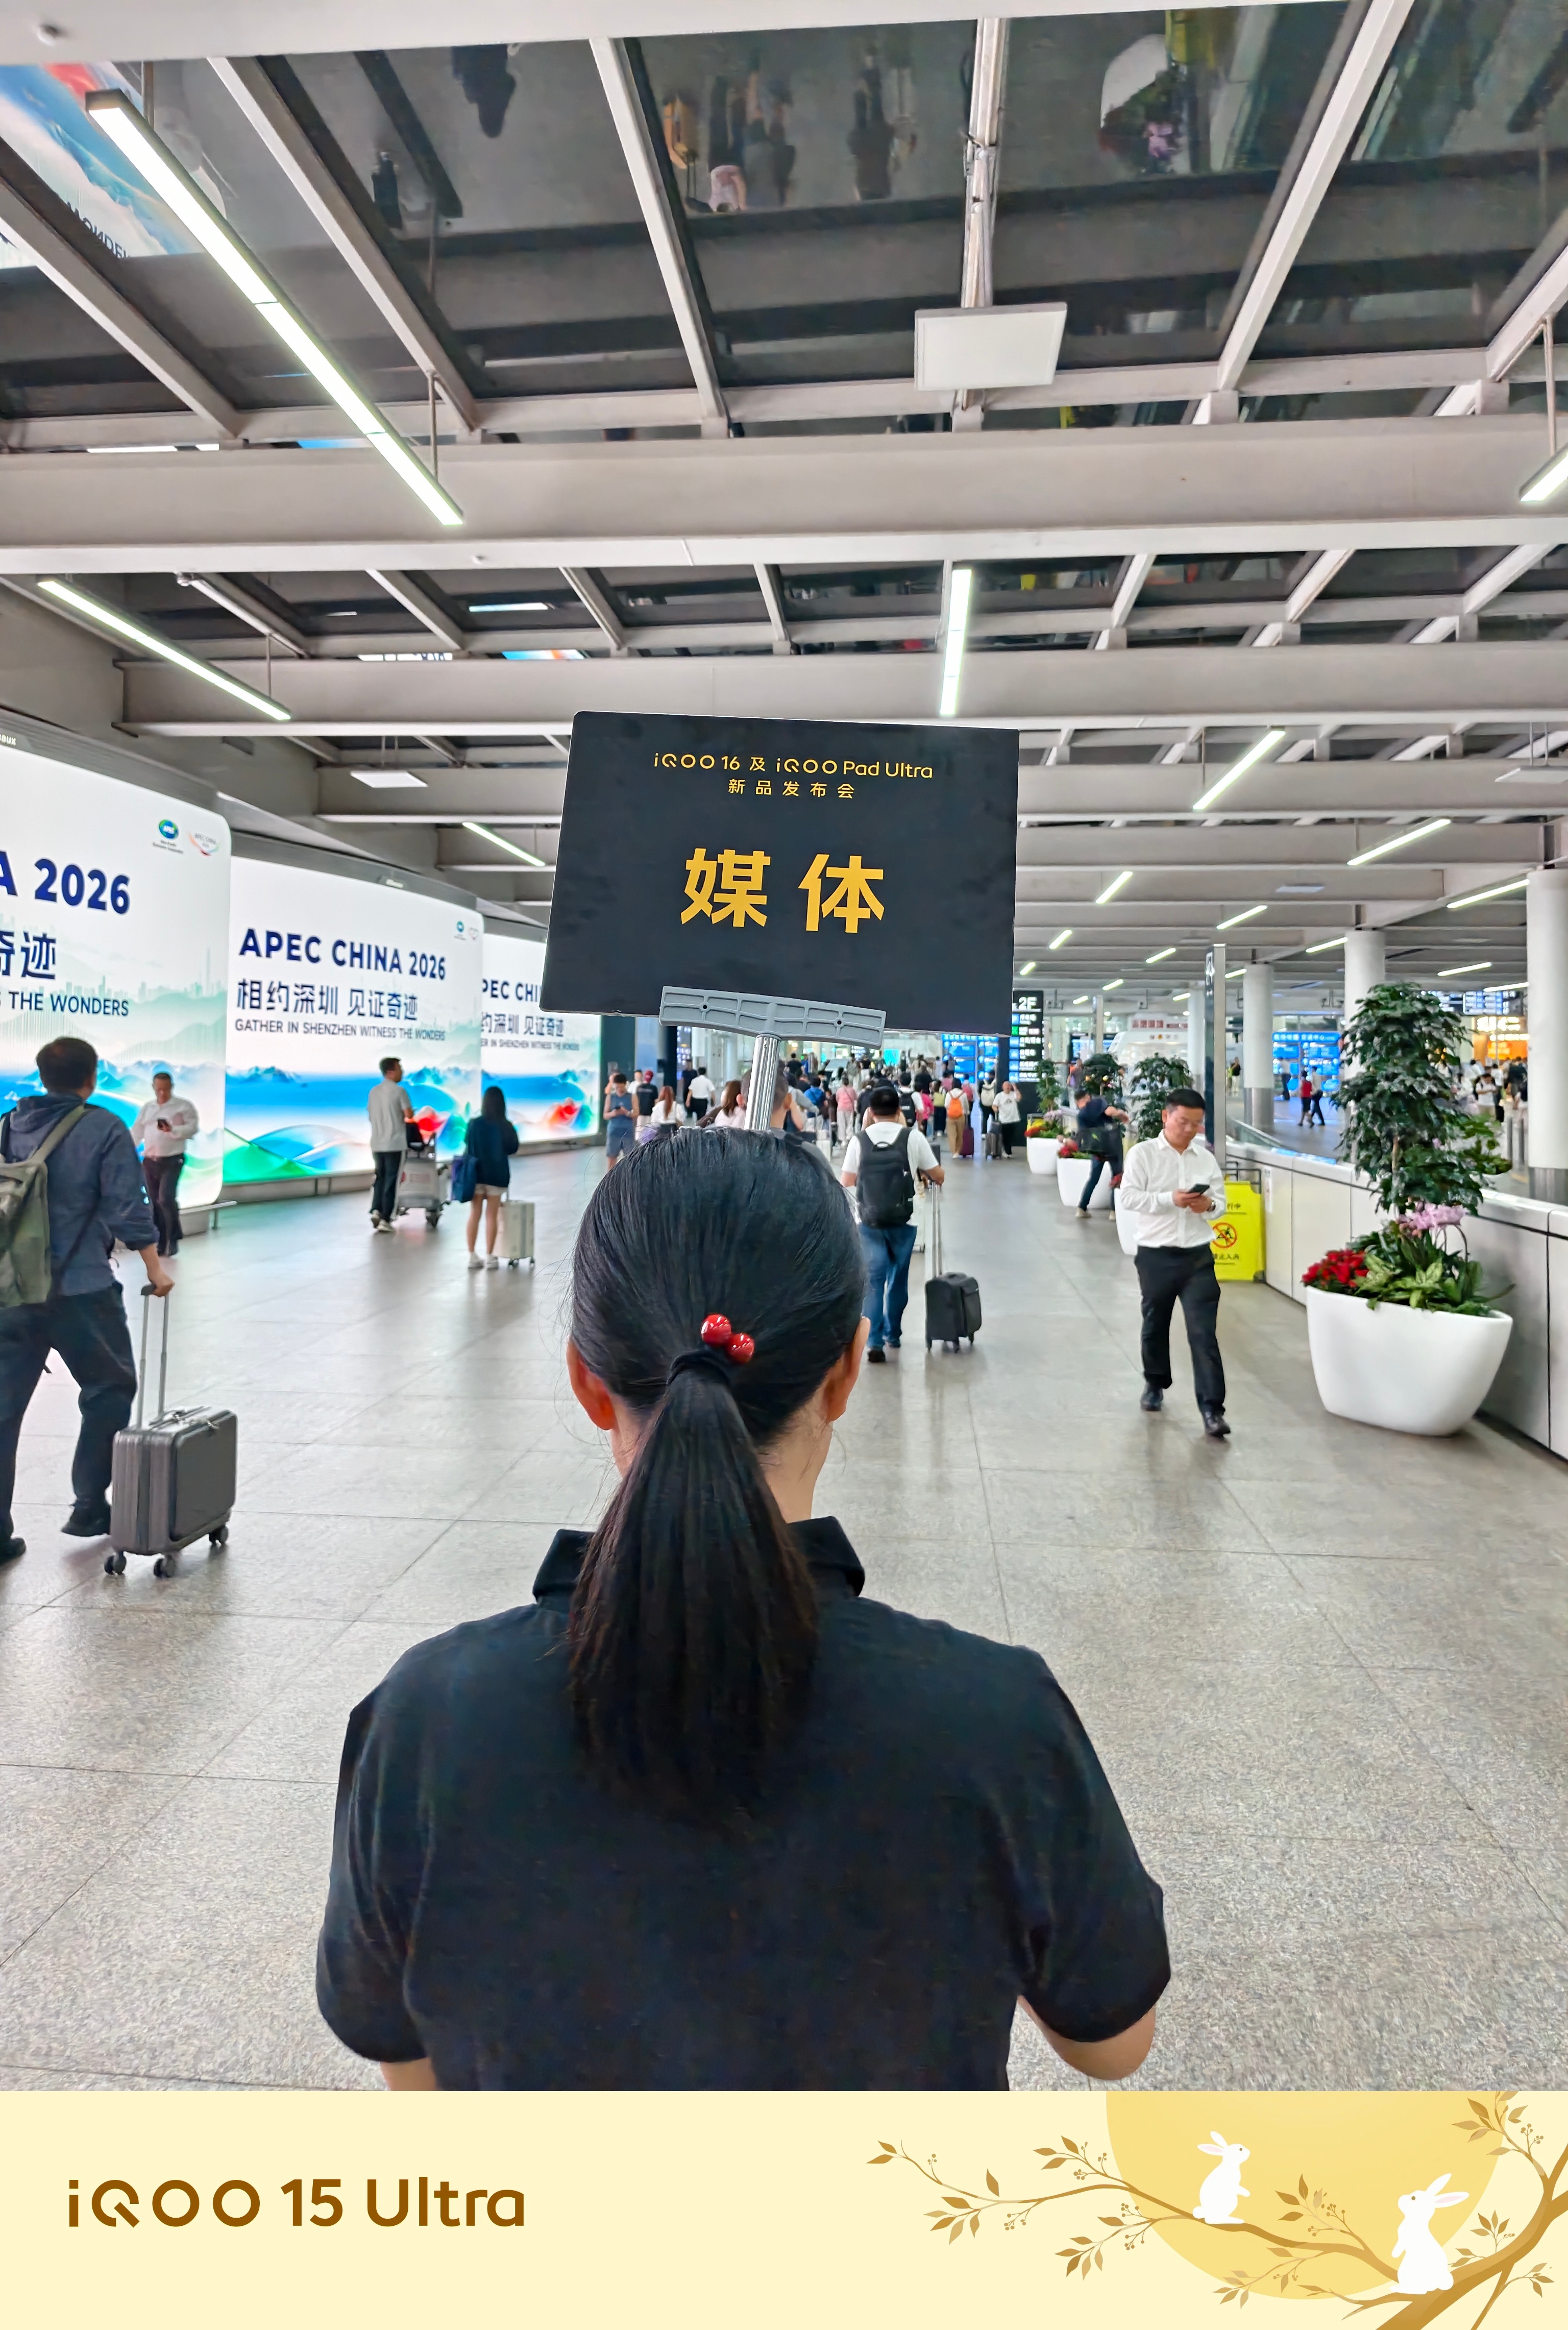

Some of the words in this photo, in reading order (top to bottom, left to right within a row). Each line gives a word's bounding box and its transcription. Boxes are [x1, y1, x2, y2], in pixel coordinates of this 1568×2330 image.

[654, 753, 715, 769] iQOO
[721, 756, 740, 770] 16
[749, 757, 766, 771] 及
[776, 758, 838, 774] iQOO
[843, 761, 880, 776] Pad
[886, 762, 933, 779] Ultra
[728, 779, 854, 798] 新品发布会
[34, 858, 130, 915] 2026
[680, 847, 885, 934] 媒体
[239, 928, 321, 963] APEC
[332, 940, 402, 974] CHINA
[409, 951, 446, 980] 2026
[9, 991, 43, 1010] THE
[50, 993, 129, 1016] WONDERS
[237, 979, 338, 1015] 相约深圳
[348, 988, 418, 1020] 见证奇迹
[516, 982, 542, 1002] CHI
[1018, 997, 1037, 1010] 2F
[235, 1018, 283, 1033] GATHER
[288, 1022, 299, 1033] IN
[303, 1022, 356, 1035] SHENZHEN
[360, 1025, 396, 1038] WITNESS
[400, 1028, 412, 1039] THE
